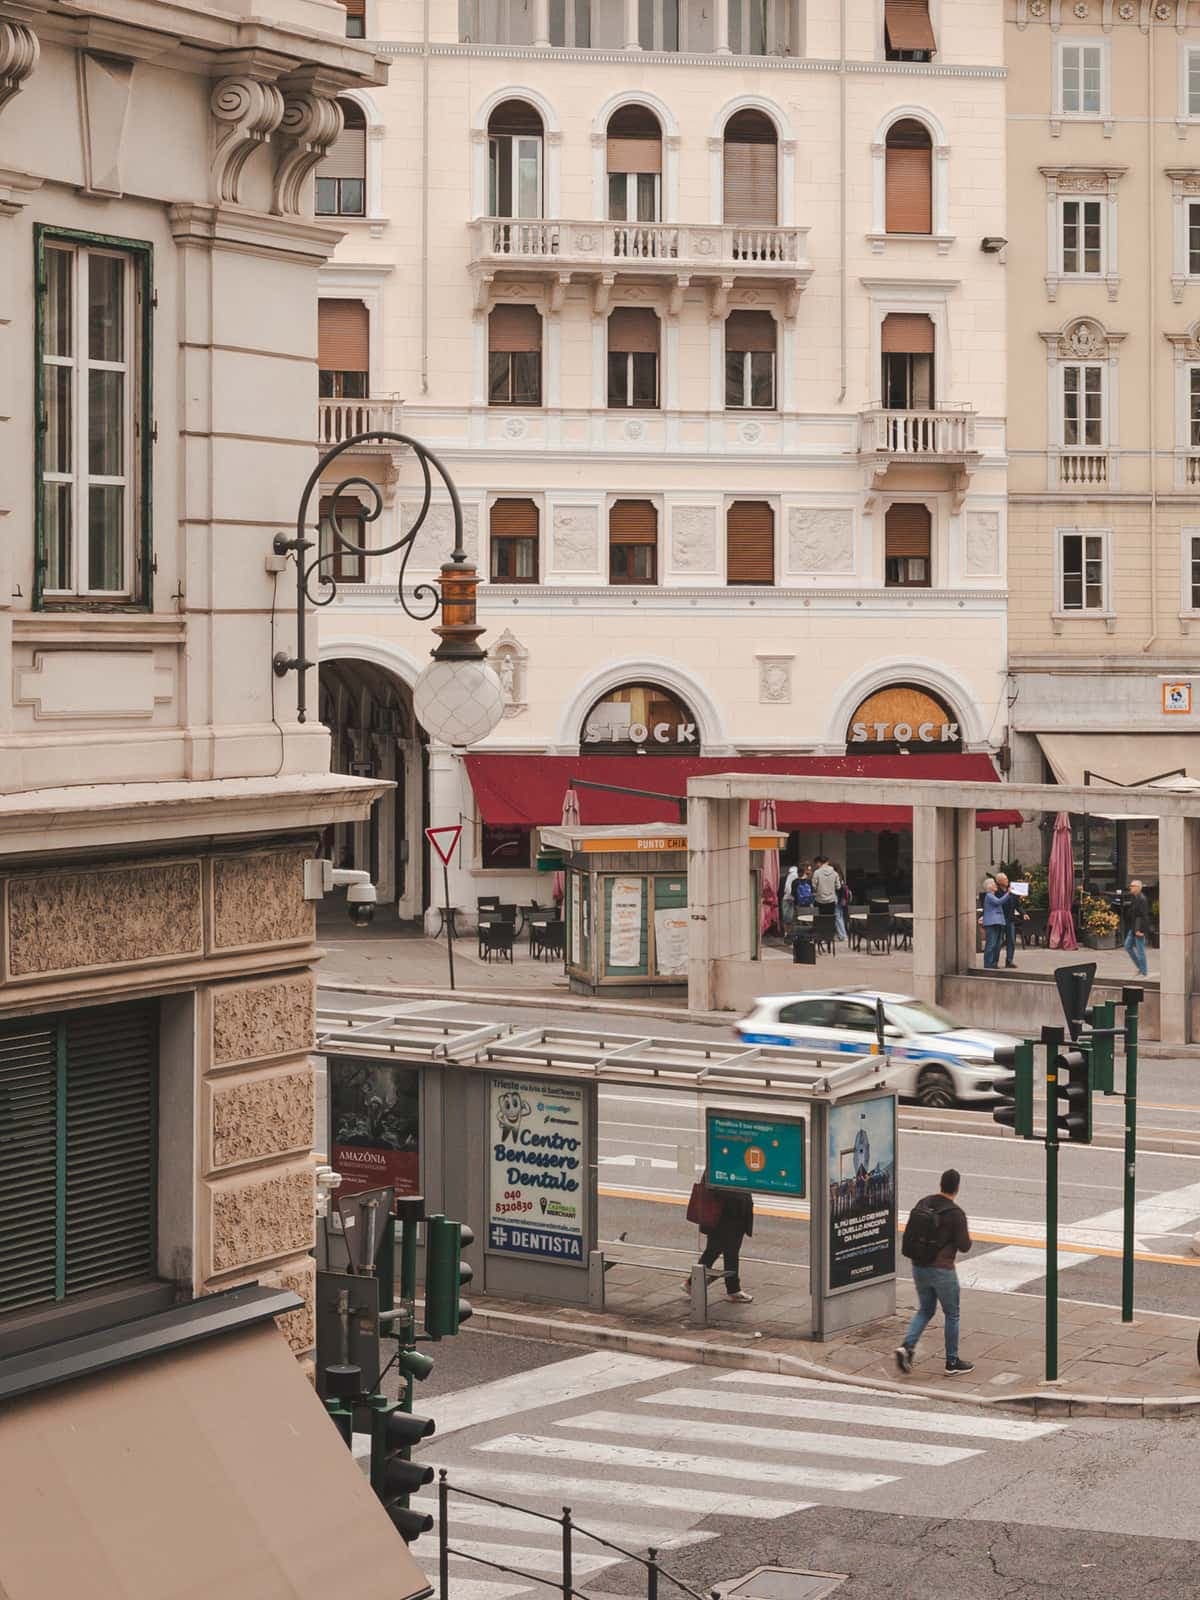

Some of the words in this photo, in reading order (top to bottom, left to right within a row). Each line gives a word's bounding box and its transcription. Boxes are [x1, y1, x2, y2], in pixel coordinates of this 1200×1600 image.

[584, 722, 696, 744] STOCK
[851, 722, 959, 743] STOCK
[637, 839, 665, 849] PUNTO
[667, 839, 688, 848] CHIA
[520, 1129, 581, 1151] Centro
[339, 1151, 386, 1164] AMAZÔNIA
[494, 1144, 580, 1170] Benessere
[506, 1167, 580, 1193] Dentale
[504, 1190, 521, 1201] 040
[495, 1200, 533, 1215] 8320830
[511, 1230, 580, 1256] DENTISTA
